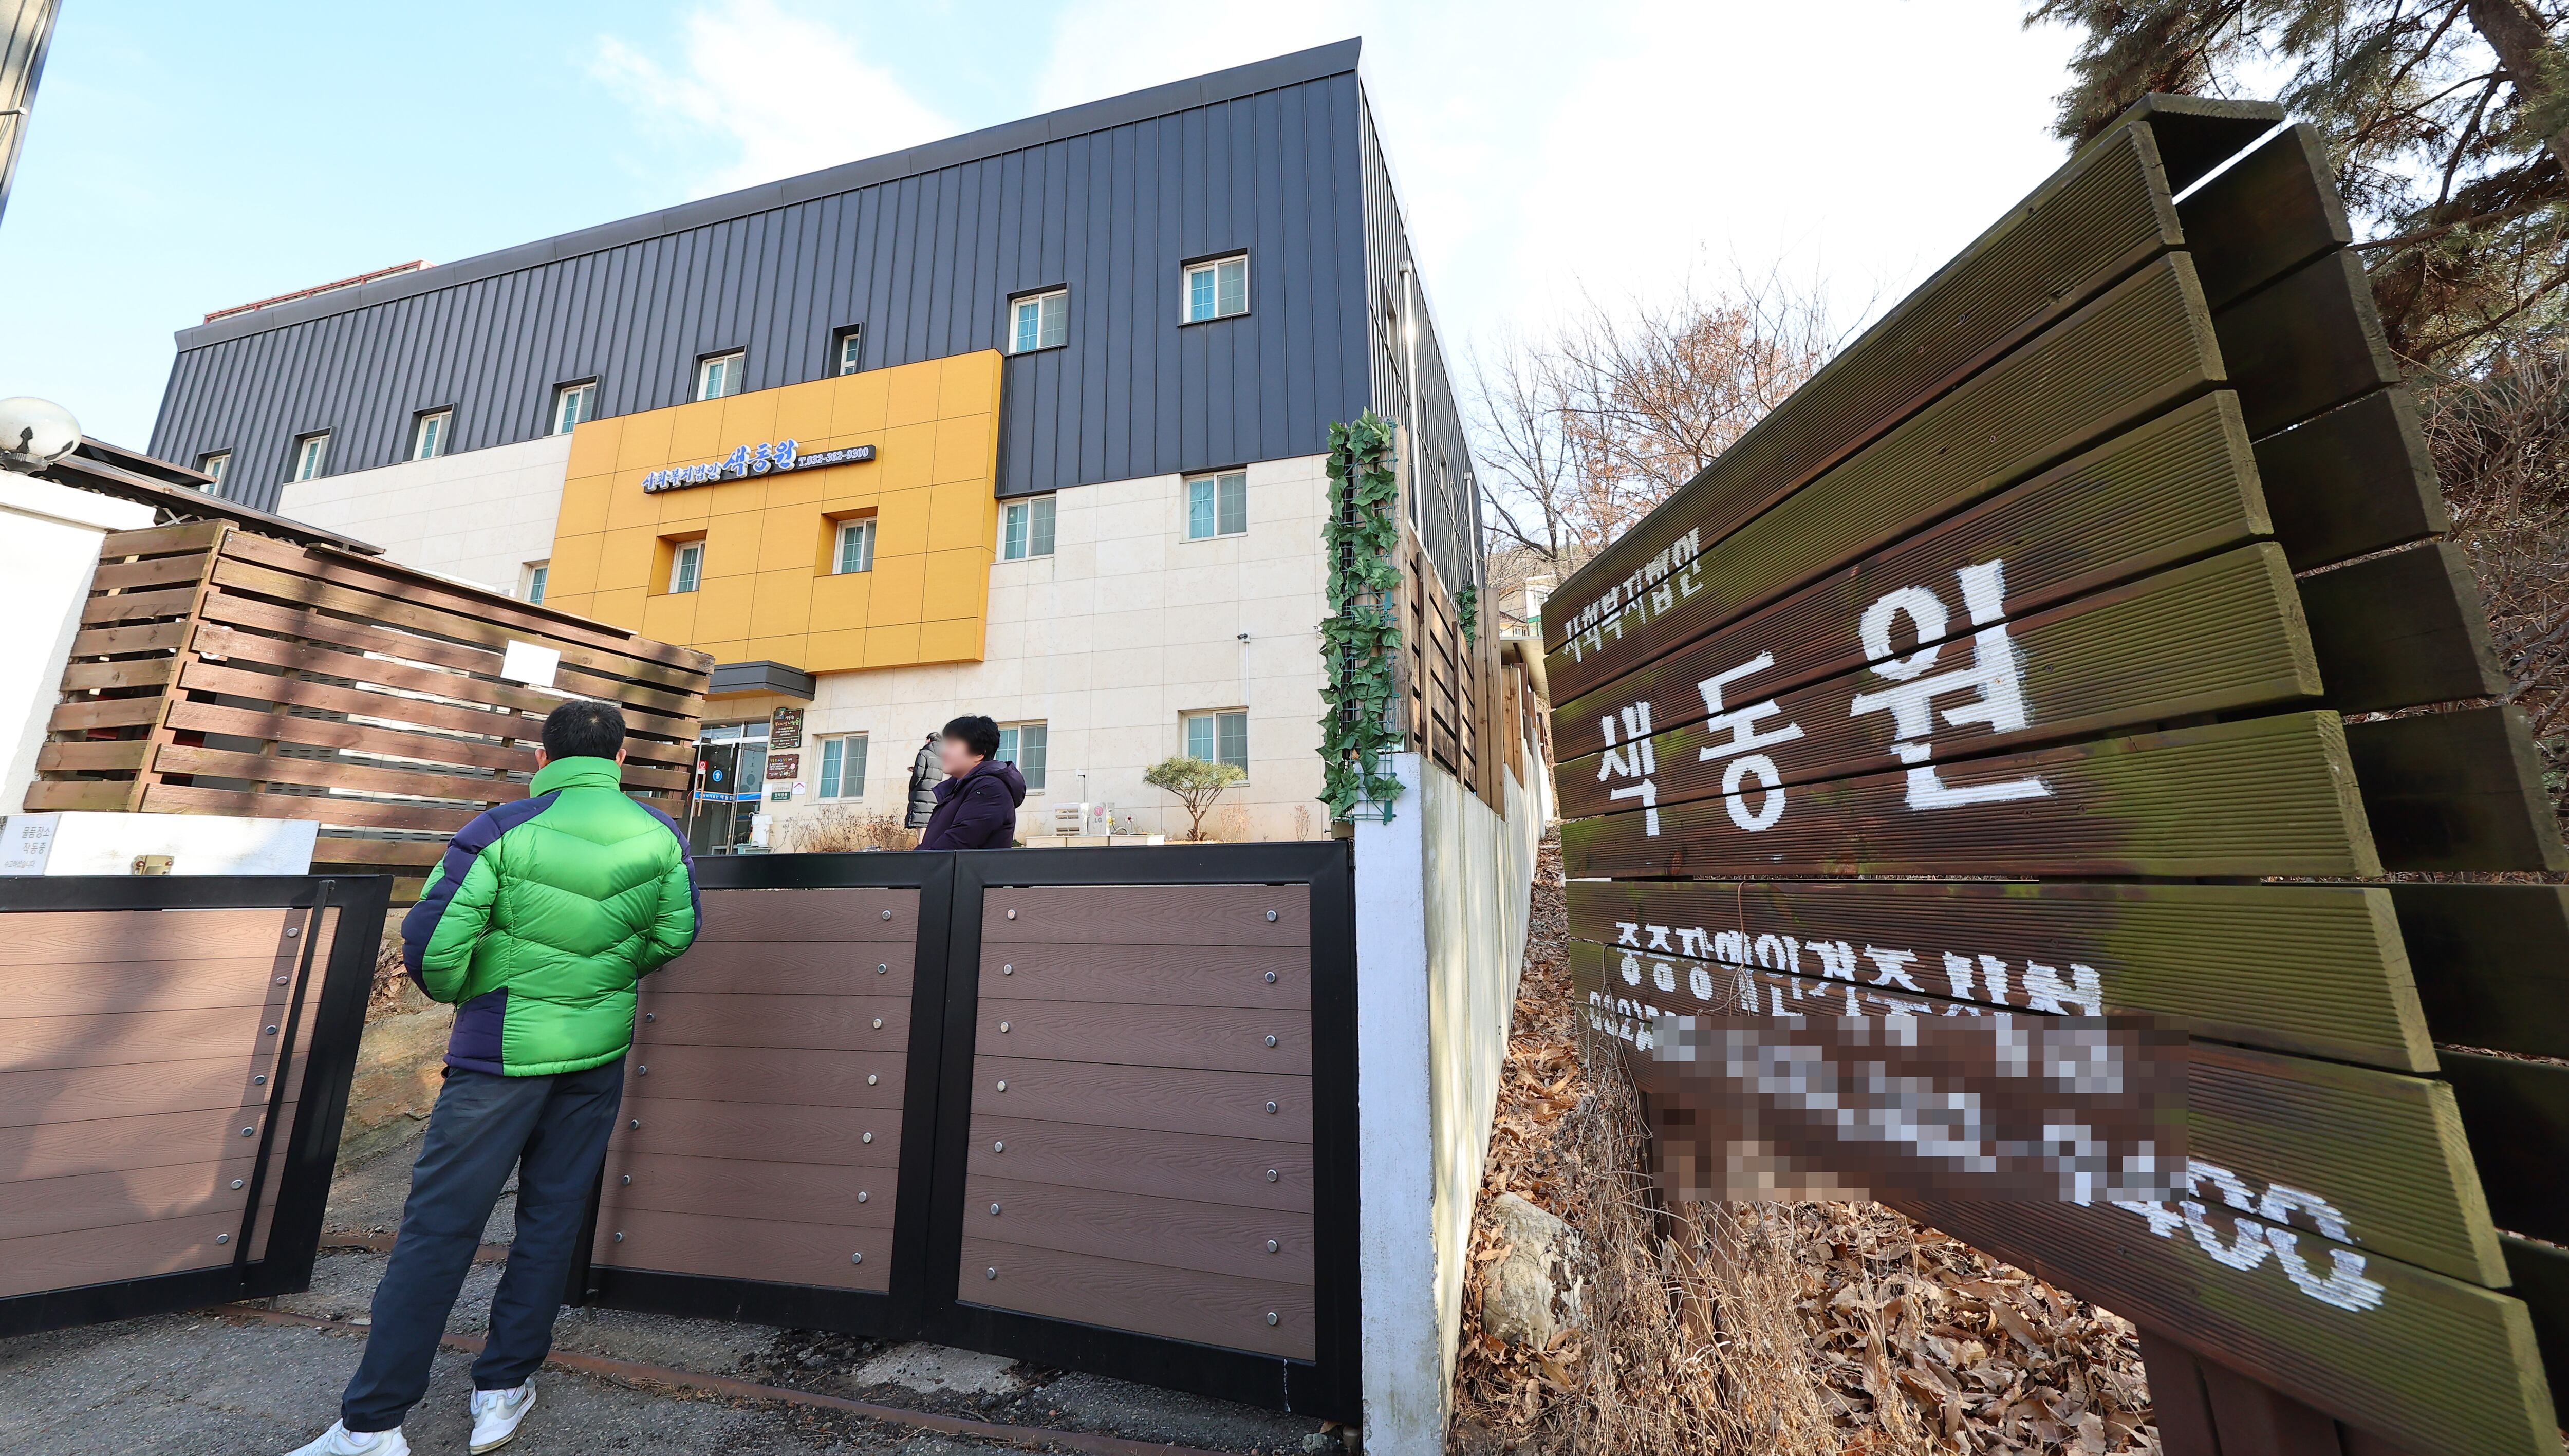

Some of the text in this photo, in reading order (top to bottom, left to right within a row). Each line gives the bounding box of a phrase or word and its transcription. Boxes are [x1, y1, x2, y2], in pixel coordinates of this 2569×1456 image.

[642, 438, 869, 490] 사회복지법인 색동원 T.032-362-9300
[1562, 526, 1704, 663] 사회복지법인
[1596, 558, 2053, 838] 색동원
[23, 842, 46, 854] 작동중
